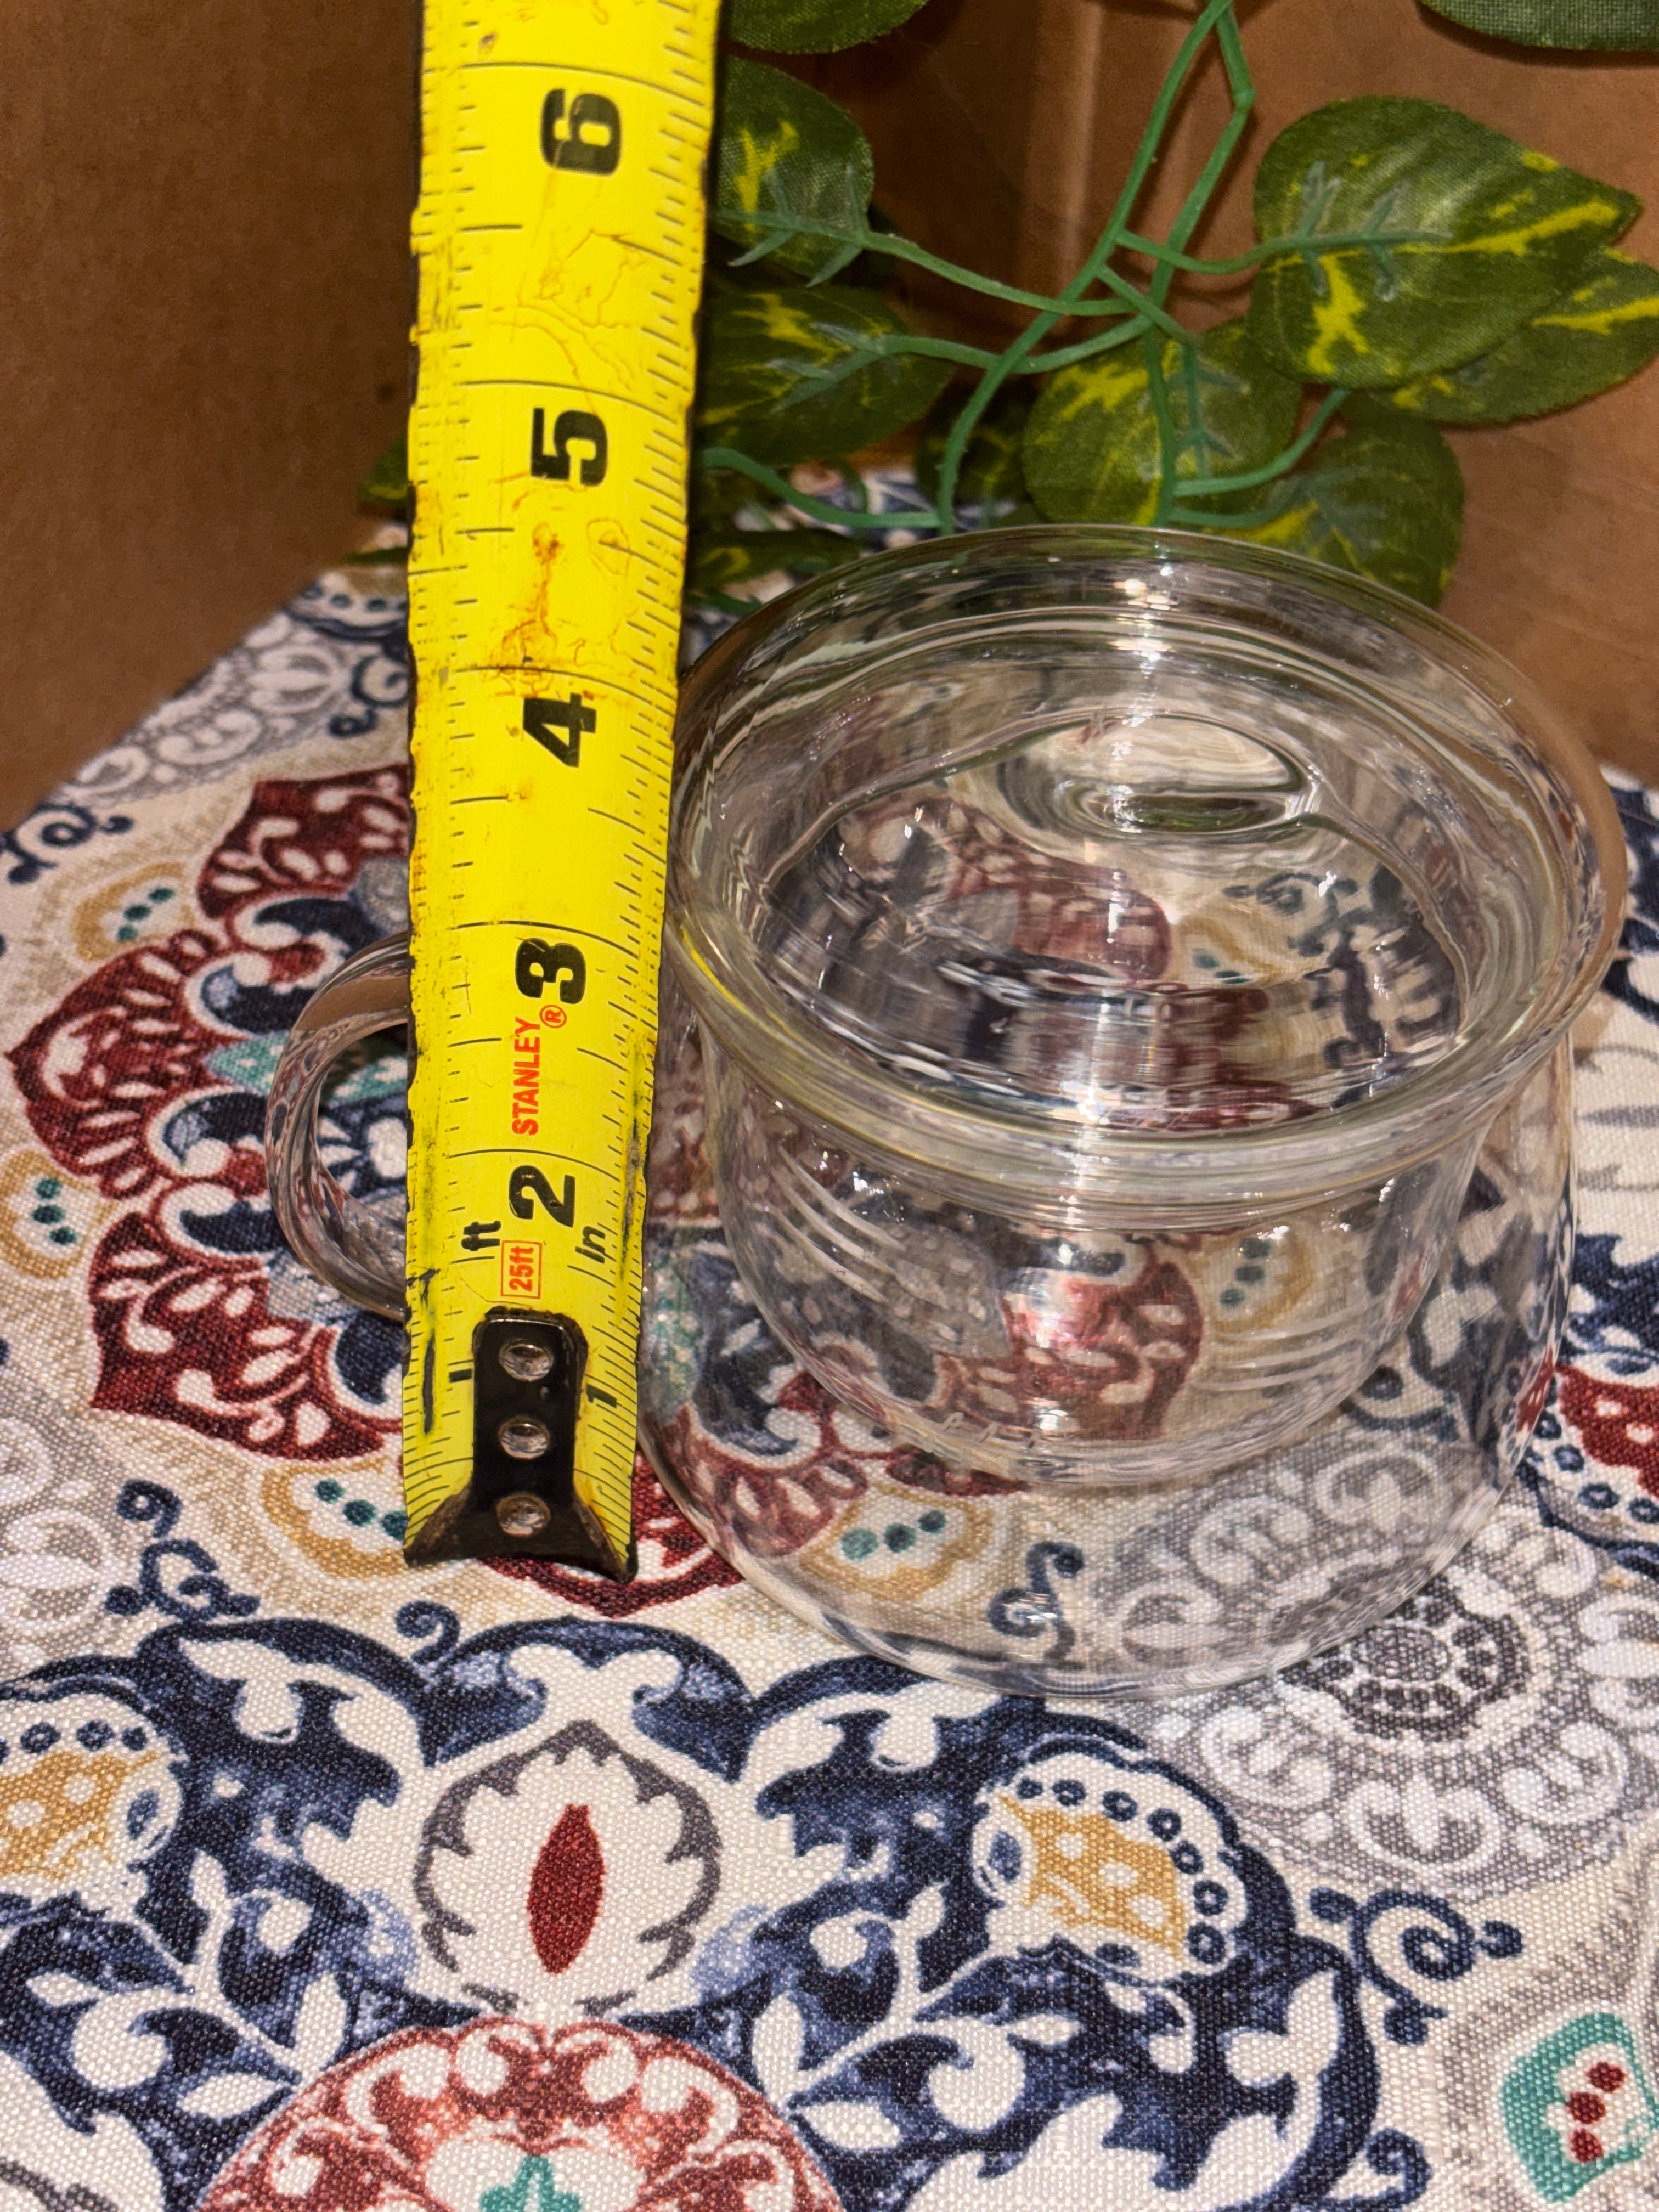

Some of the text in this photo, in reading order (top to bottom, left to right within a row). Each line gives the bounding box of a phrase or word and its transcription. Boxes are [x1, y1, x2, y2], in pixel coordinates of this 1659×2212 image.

[540, 88, 621, 176] 6
[531, 408, 608, 487] 5
[522, 692, 597, 768] 4
[515, 938, 586, 1005] 3
[509, 1165, 575, 1228] 2
[461, 1220, 501, 1252] ft
[574, 1226, 606, 1264] in
[509, 1246, 534, 1292] 25ft
